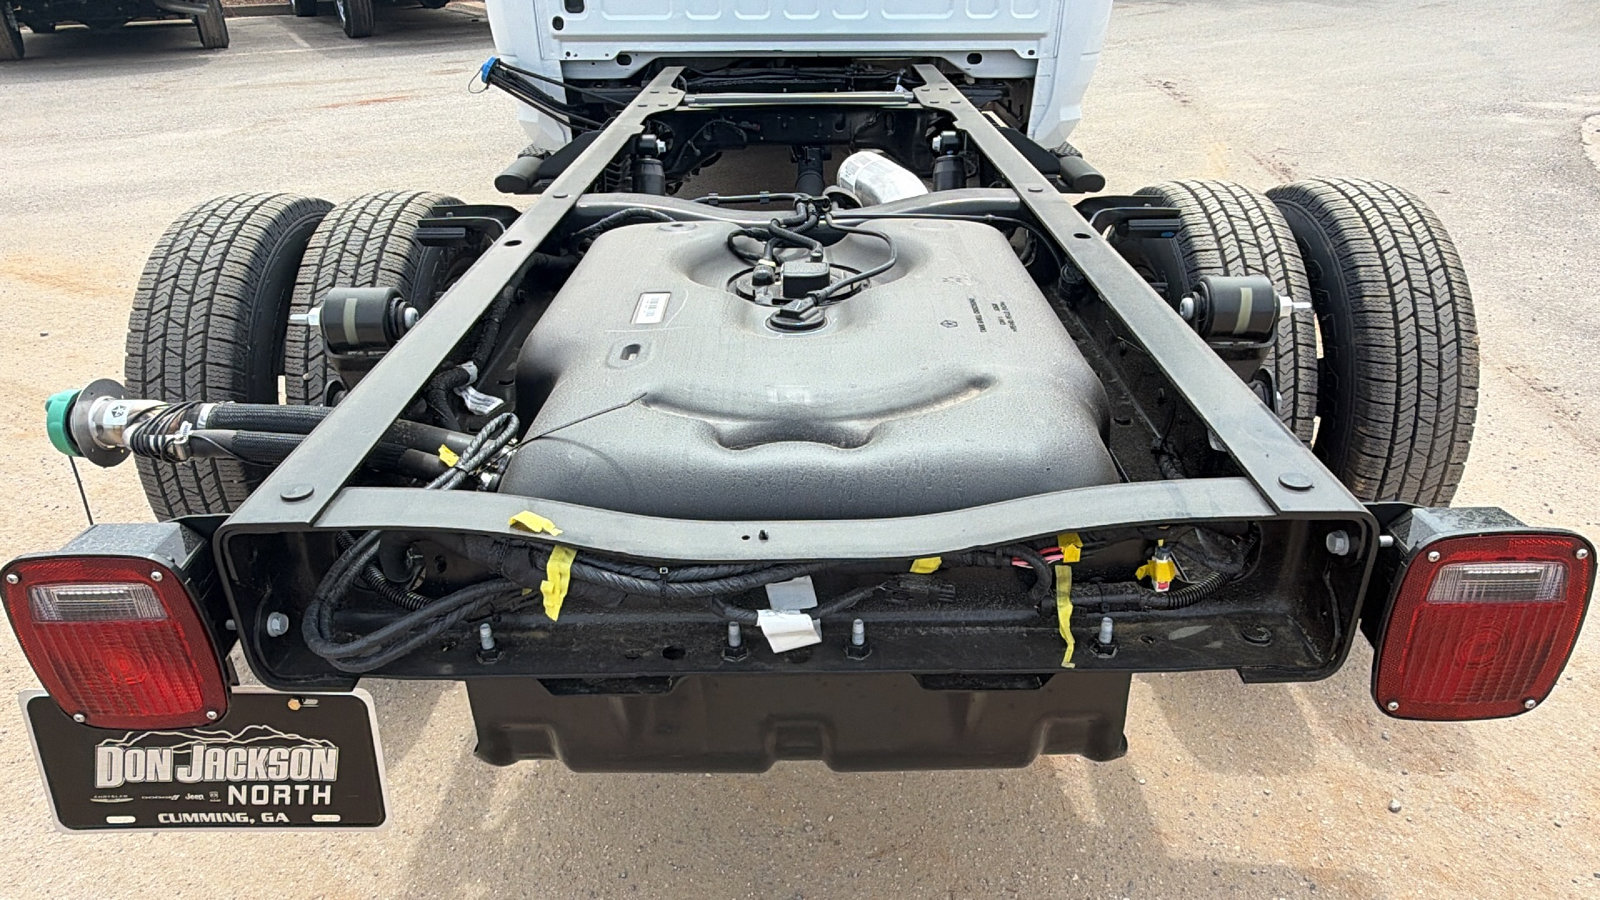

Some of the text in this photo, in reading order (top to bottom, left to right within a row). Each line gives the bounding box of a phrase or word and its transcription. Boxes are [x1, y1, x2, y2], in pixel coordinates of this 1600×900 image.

[95, 743, 339, 788] DON JACKSON
[185, 793, 205, 801] Jeep
[227, 785, 332, 806] NORTH
[157, 812, 290, 825] CUMMING, GA
